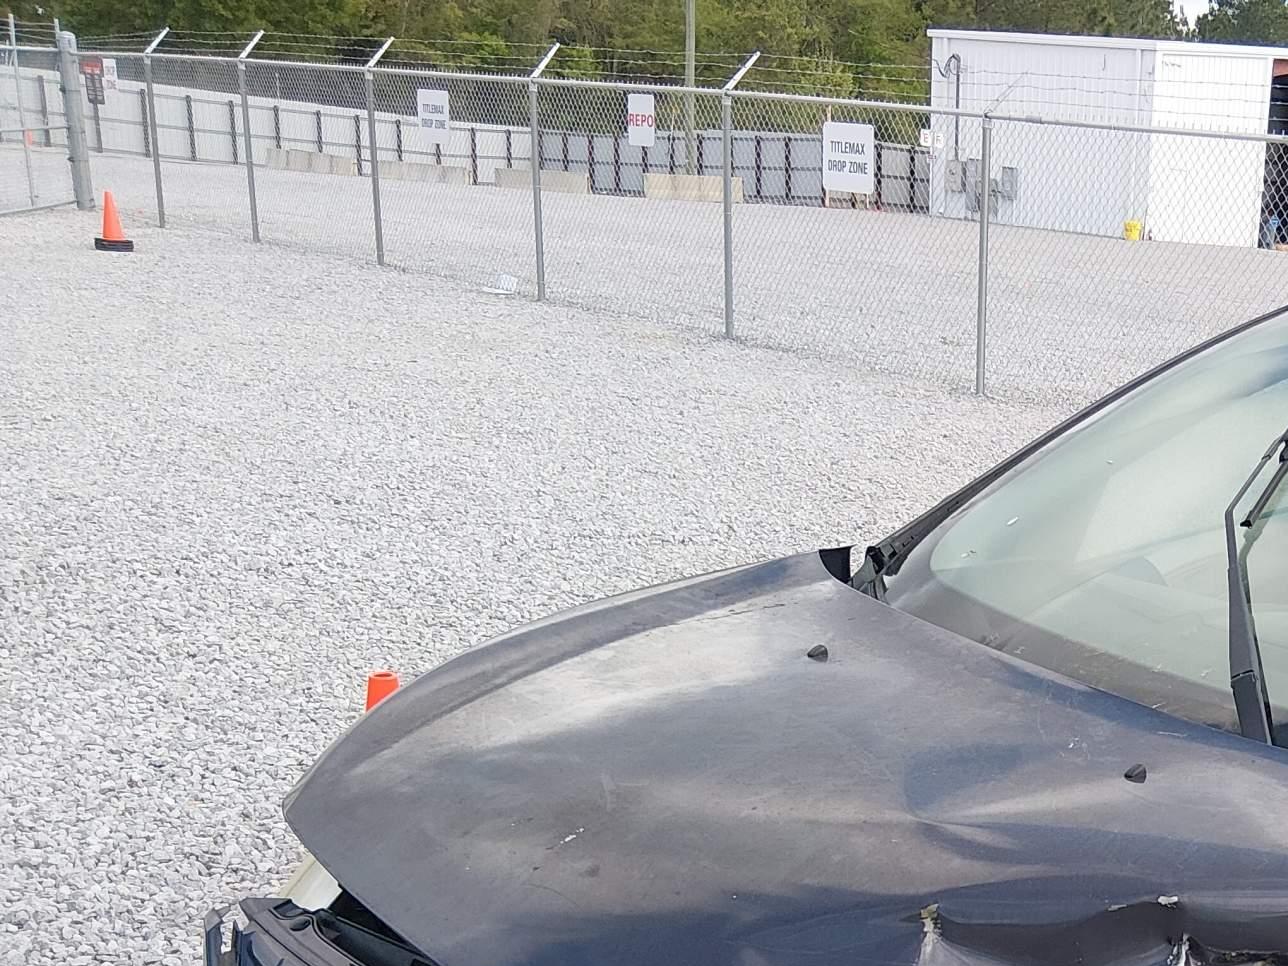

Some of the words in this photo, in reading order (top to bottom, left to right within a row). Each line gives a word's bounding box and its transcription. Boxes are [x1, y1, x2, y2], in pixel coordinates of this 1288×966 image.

[628, 113, 654, 128] REPO
[830, 140, 865, 156] TITLEMAX
[827, 159, 847, 173] DROP
[848, 161, 868, 175] ZONE
